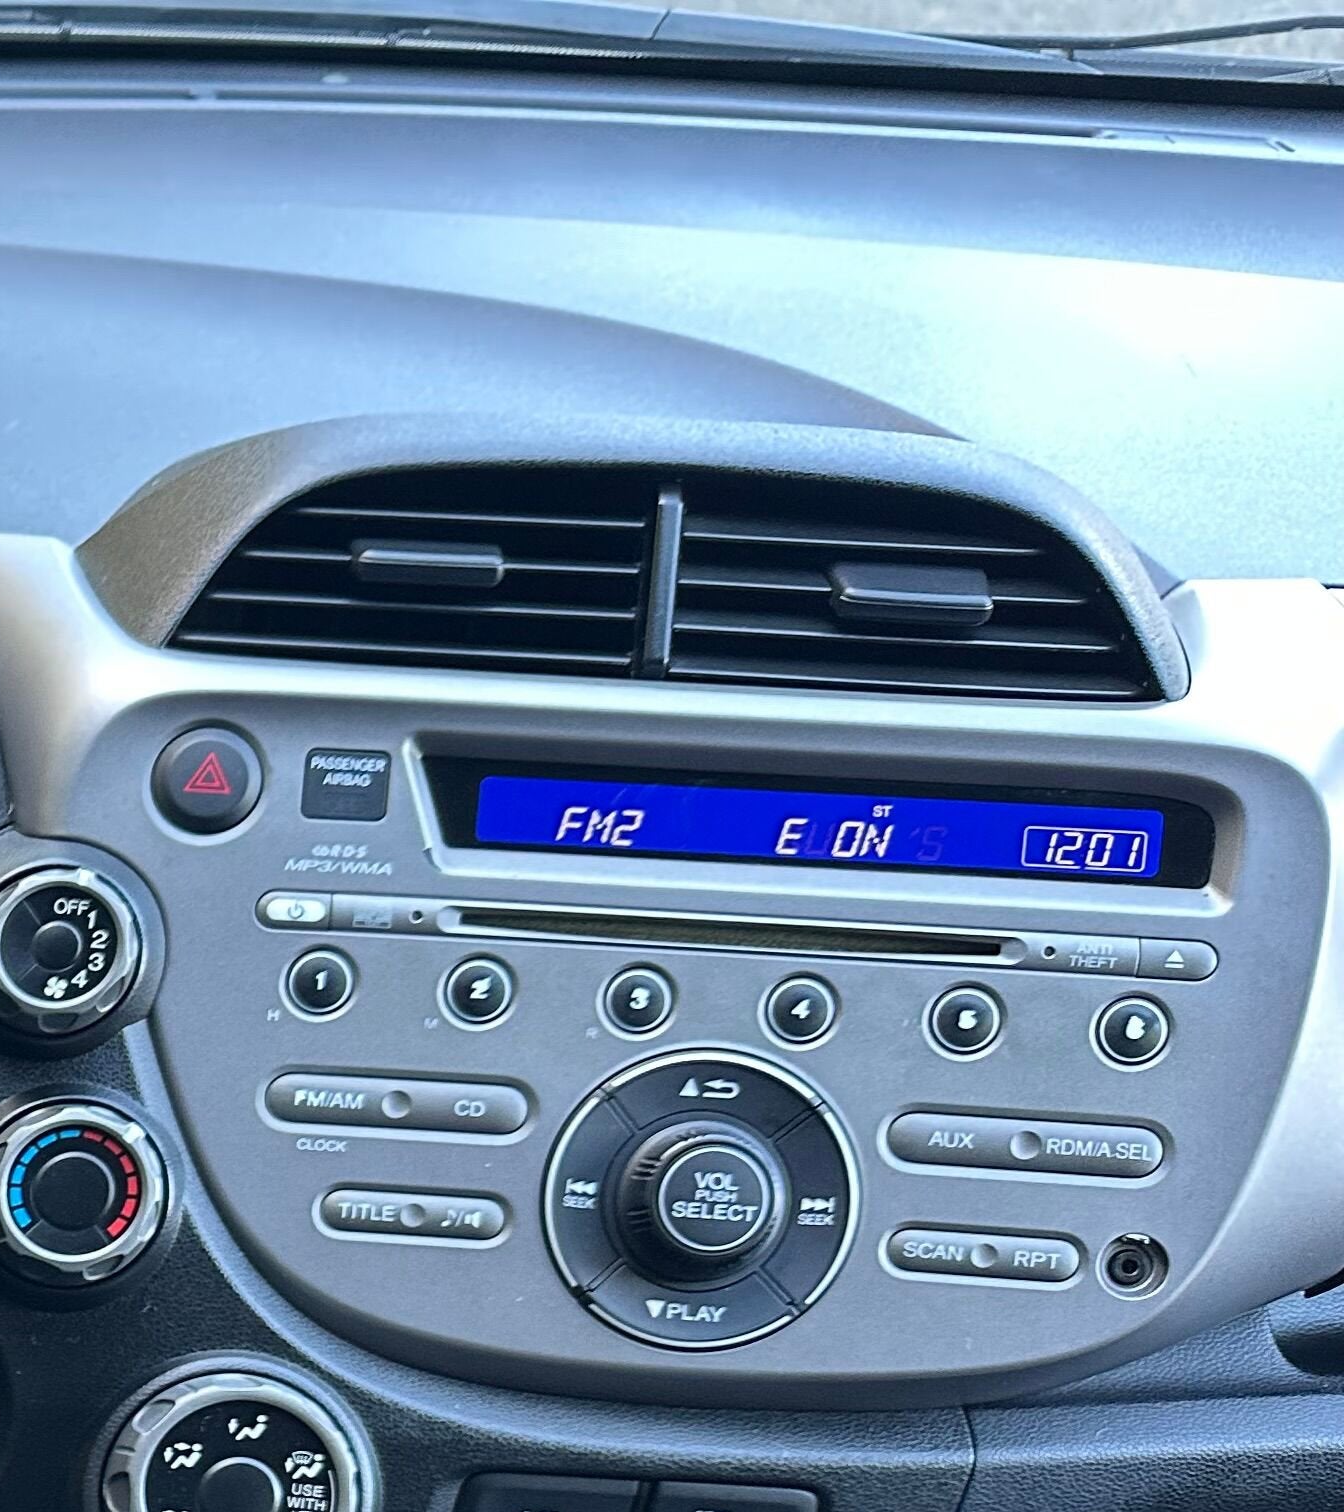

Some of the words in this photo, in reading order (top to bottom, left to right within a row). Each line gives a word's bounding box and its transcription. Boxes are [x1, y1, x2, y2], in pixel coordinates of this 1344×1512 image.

[311, 756, 387, 772] PASSENGER
[322, 772, 372, 787] AIRBAG
[872, 805, 893, 818] ST
[555, 806, 645, 847] FM2
[284, 859, 392, 876] MP3/WMA
[53, 898, 90, 916] OFF
[88, 910, 98, 929] 1
[90, 930, 109, 949] 2
[1077, 944, 1112, 955] ANTI
[88, 953, 105, 972] 3
[1069, 955, 1118, 969] THEFT
[71, 969, 88, 989] 4
[314, 970, 328, 990] 1
[470, 975, 492, 999] 2
[629, 987, 649, 1010] 3
[791, 999, 811, 1020] 4
[293, 1090, 366, 1110] FM/AM
[453, 1099, 486, 1117] CD
[296, 1138, 346, 1153] CLOCK
[928, 1130, 975, 1150] AUX
[694, 1172, 739, 1191] VOL
[562, 1196, 595, 1208] SEEK
[695, 1190, 737, 1203] PUSH
[338, 1201, 398, 1222] TITLE
[671, 1201, 758, 1222] SELECT
[797, 1214, 835, 1226] SEEK
[902, 1242, 964, 1262] SCAN
[1012, 1250, 1060, 1269] RPT
[666, 1302, 726, 1322] PLAY
[291, 1483, 326, 1498] USE
[287, 1496, 327, 1511] WITH
